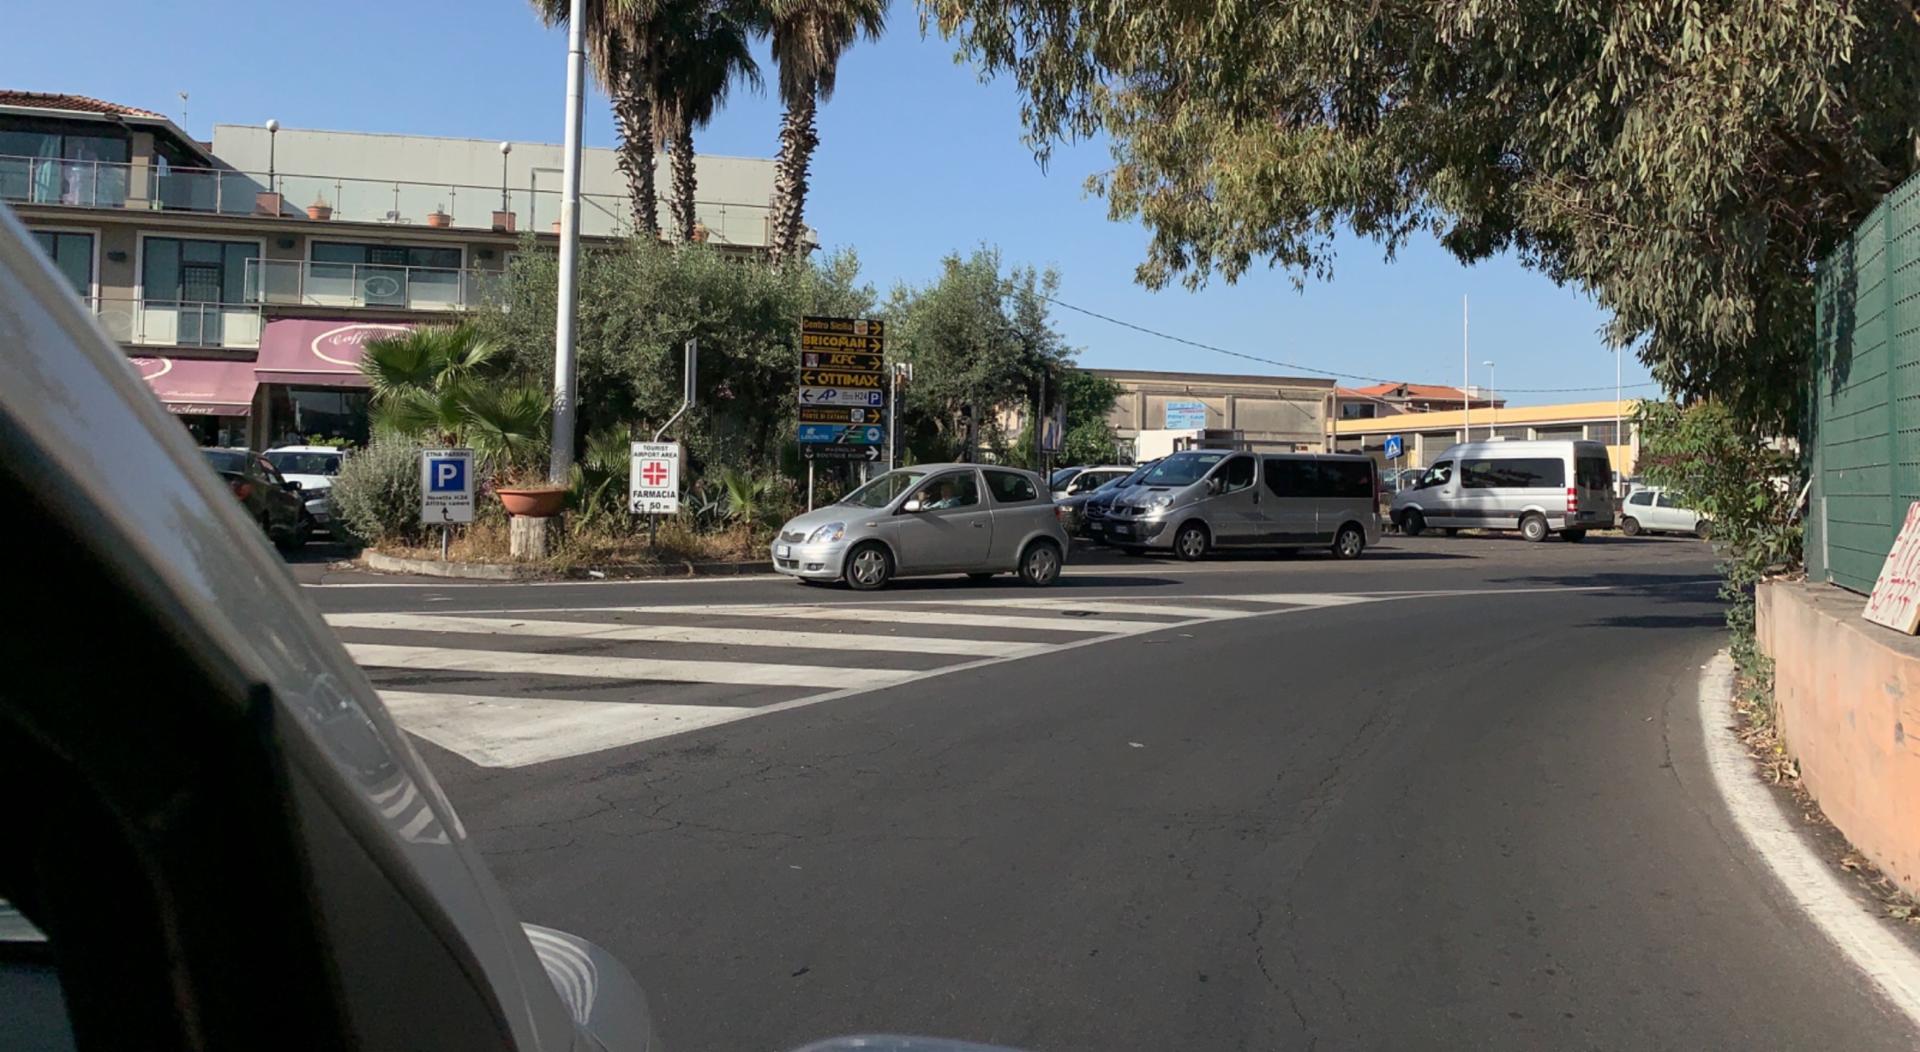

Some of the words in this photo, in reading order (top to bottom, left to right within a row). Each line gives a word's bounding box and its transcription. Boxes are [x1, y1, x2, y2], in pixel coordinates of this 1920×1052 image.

[803, 335, 867, 348] BRICOMAN
[831, 353, 857, 365] KFC
[818, 372, 880, 387] OTTIMAX
[870, 393, 880, 404] P
[438, 463, 457, 488] P
[633, 490, 676, 499] FARMACIA
[649, 502, 661, 510] 50
